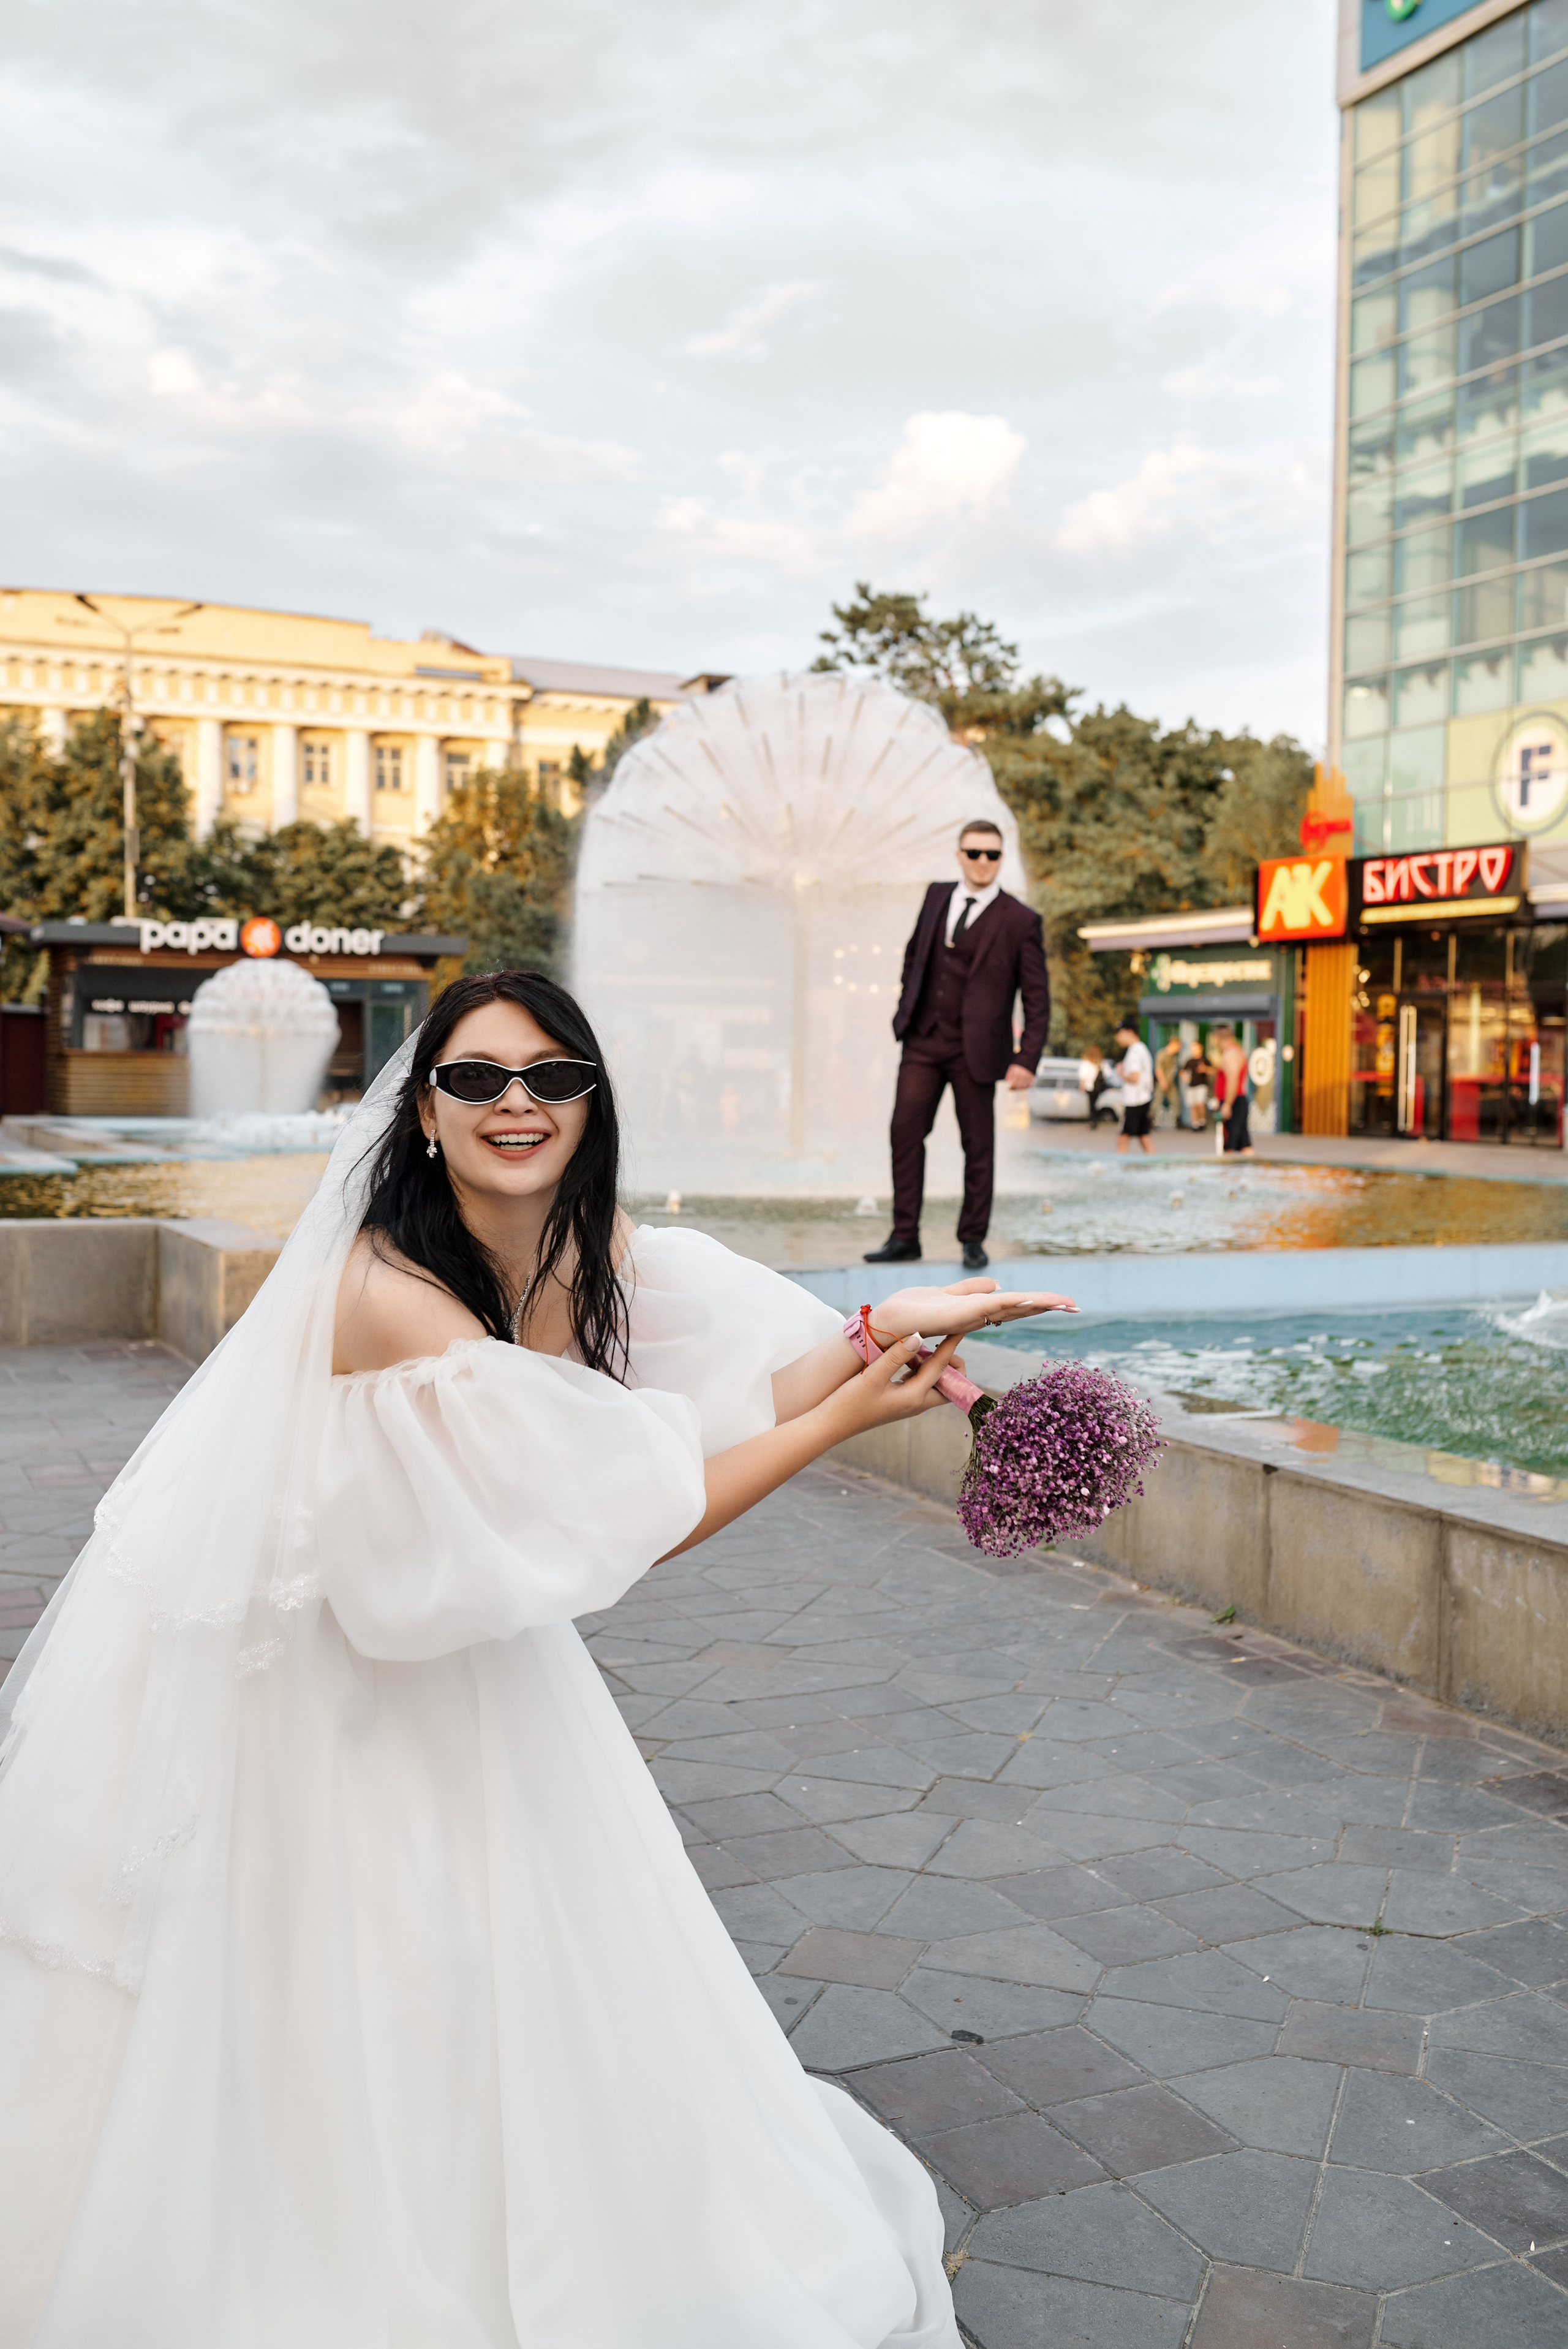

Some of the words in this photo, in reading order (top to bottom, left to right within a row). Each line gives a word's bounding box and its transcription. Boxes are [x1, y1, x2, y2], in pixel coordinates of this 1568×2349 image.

[1363, 845, 1513, 904] БИСТРО
[140, 919, 238, 955] papa
[285, 920, 385, 955] doner
